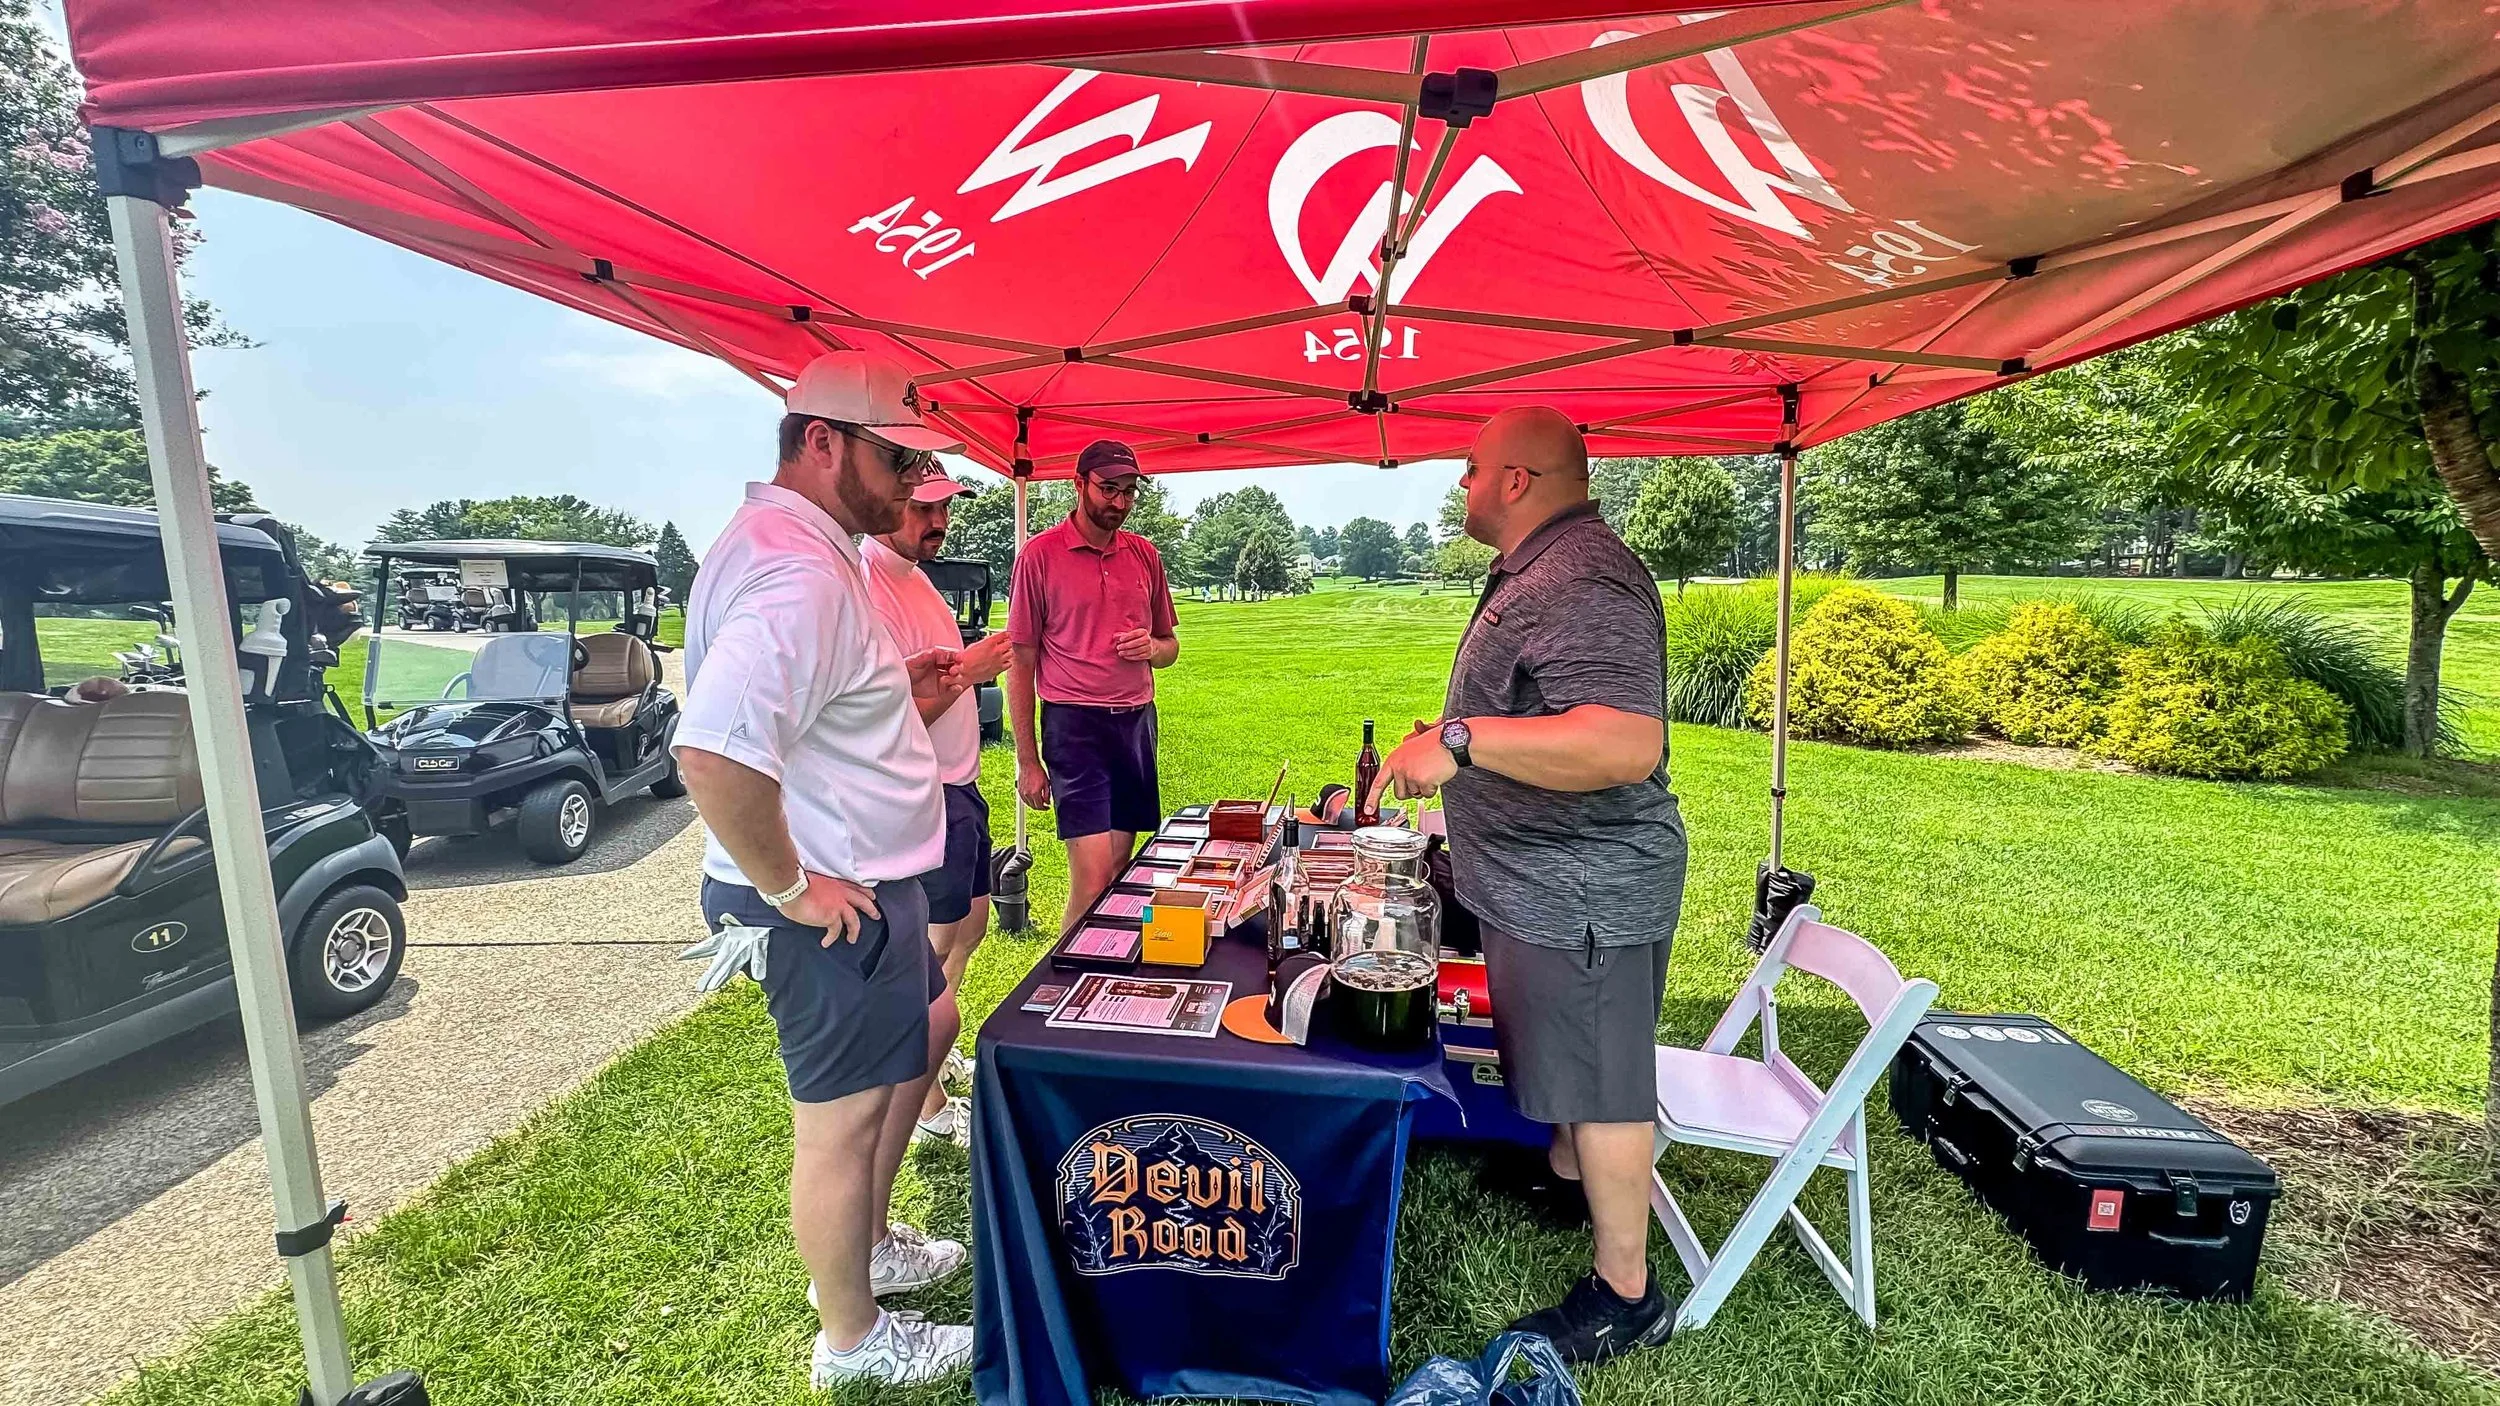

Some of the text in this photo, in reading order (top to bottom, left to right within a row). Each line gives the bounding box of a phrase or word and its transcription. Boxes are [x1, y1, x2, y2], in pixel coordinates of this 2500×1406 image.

[148, 927, 171, 946] 11
[2121, 1127, 2201, 1141] PELICAN
[1088, 1141, 1267, 1214] Devil
[1106, 1205, 1249, 1264] Road
